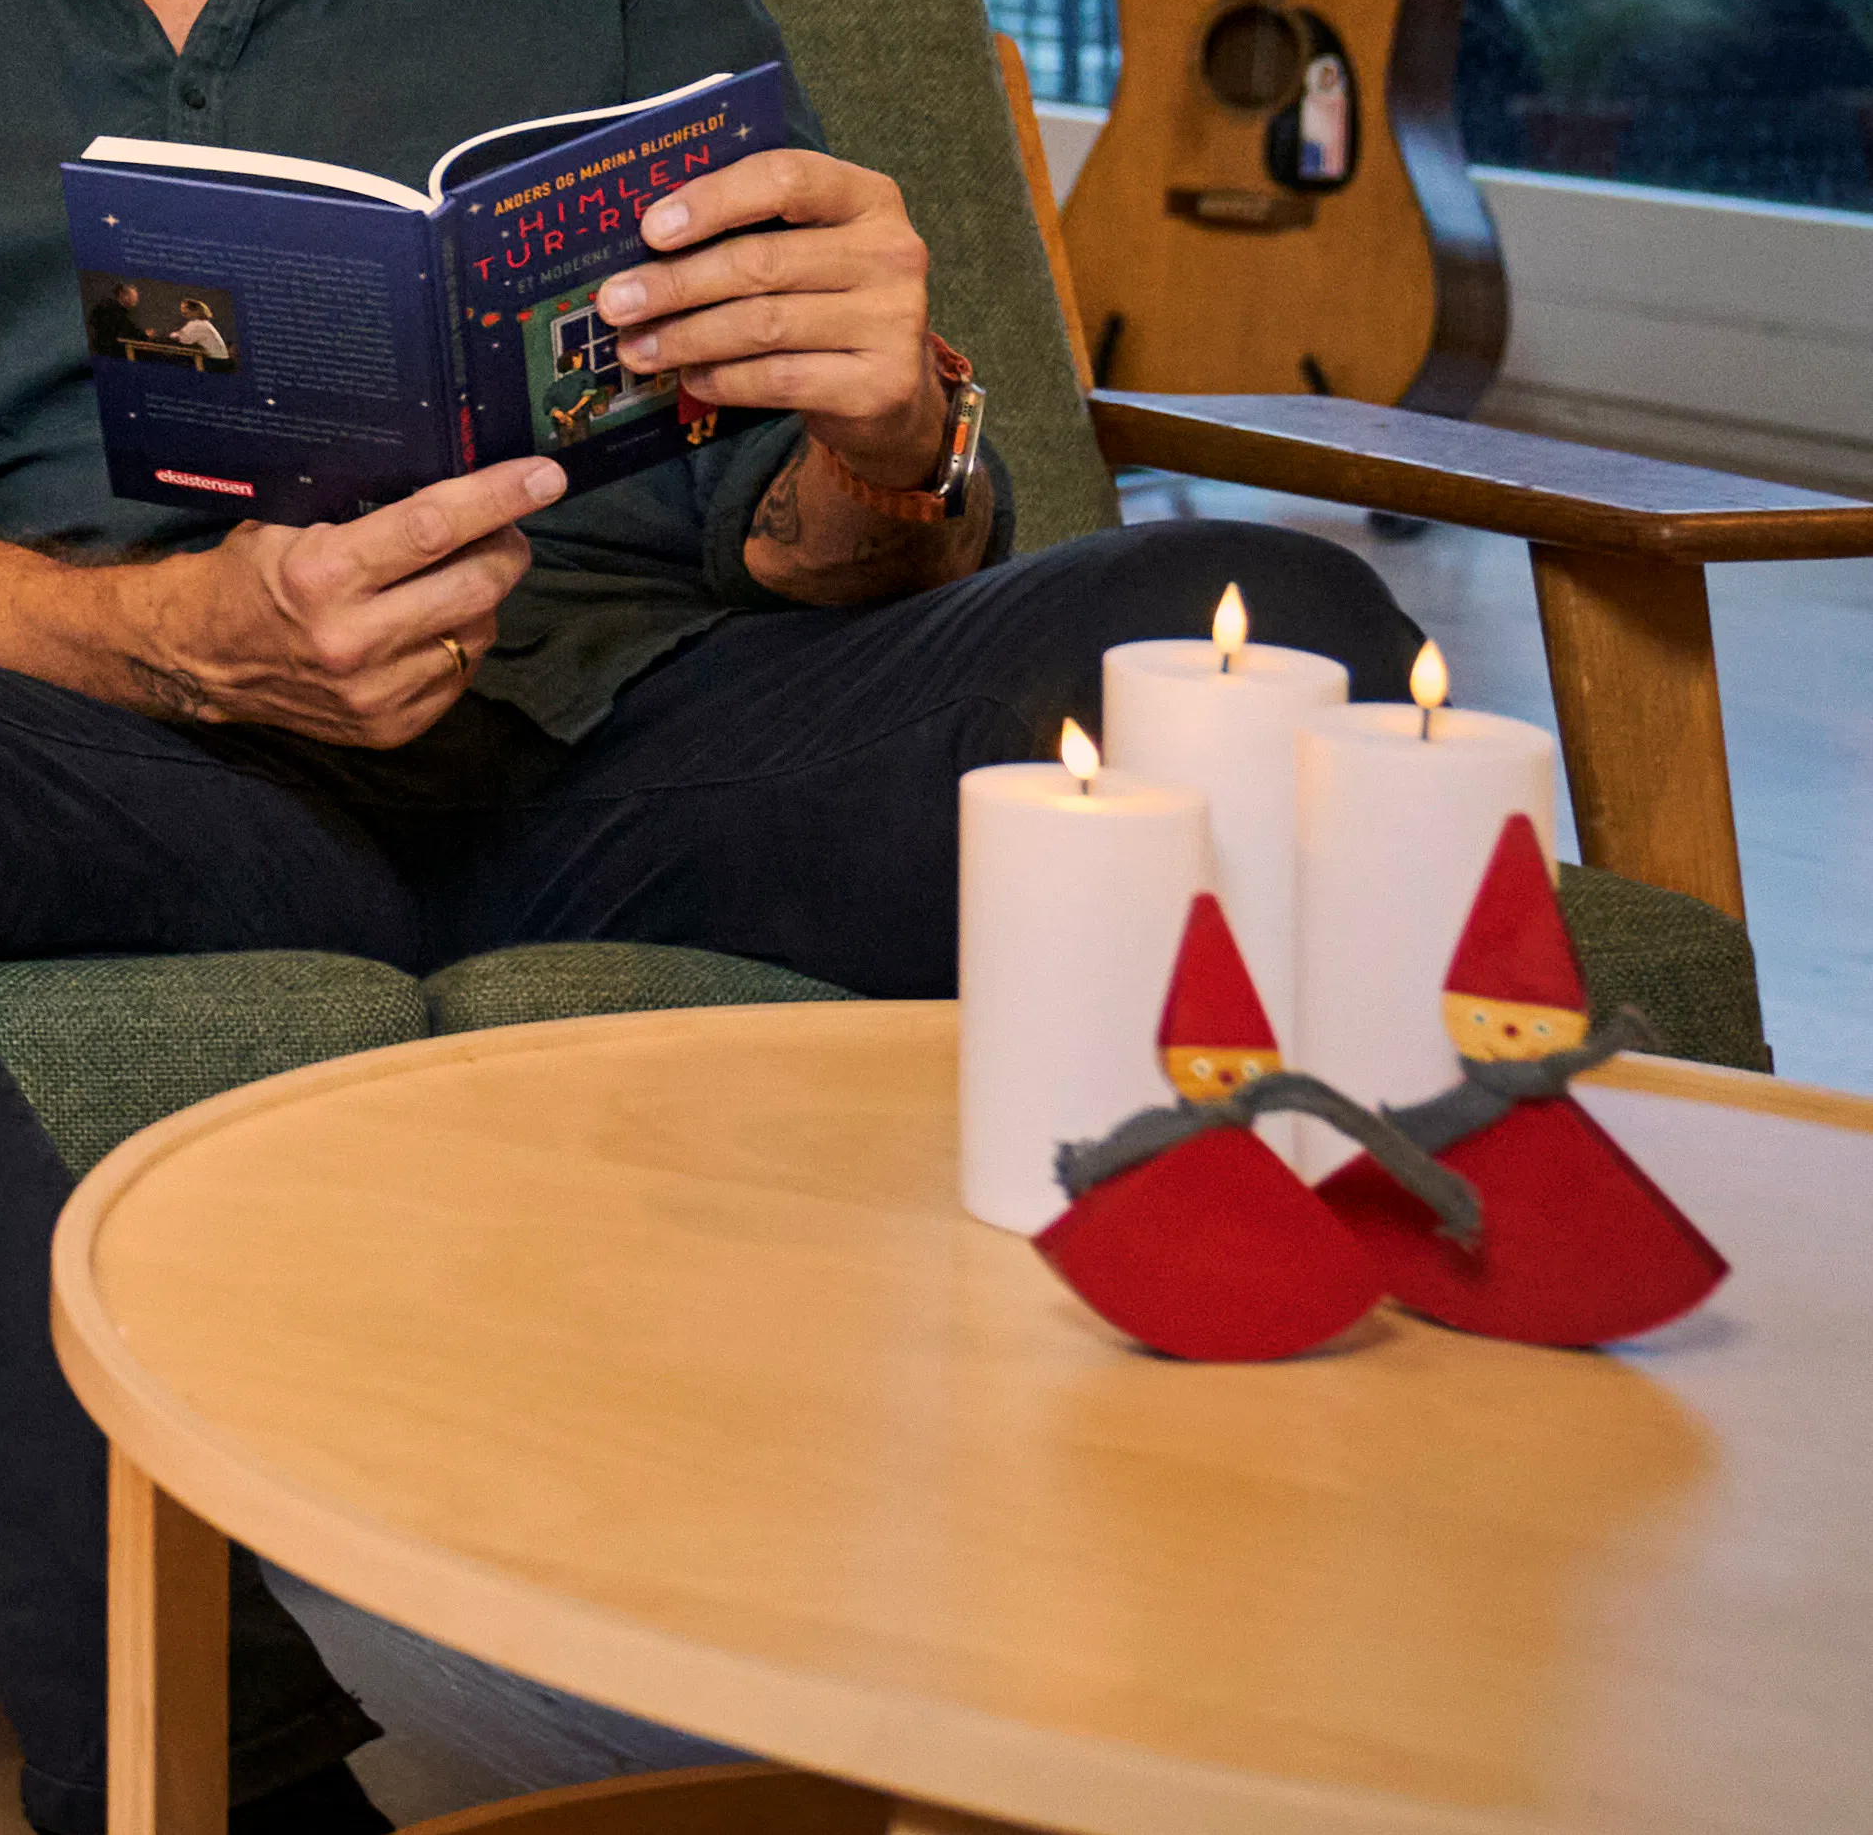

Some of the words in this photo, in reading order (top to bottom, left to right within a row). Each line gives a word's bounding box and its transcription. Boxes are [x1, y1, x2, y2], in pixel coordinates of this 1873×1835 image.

[494, 181, 552, 217] ANDERS
[555, 172, 576, 192] OG
[580, 148, 636, 181] MARINA
[640, 113, 727, 157] BLICHFELDT
[518, 144, 711, 239] HIMLEN
[472, 179, 687, 282] TUR-RE
[540, 243, 612, 285] MODERNE
[157, 468, 252, 496] eksistensen
